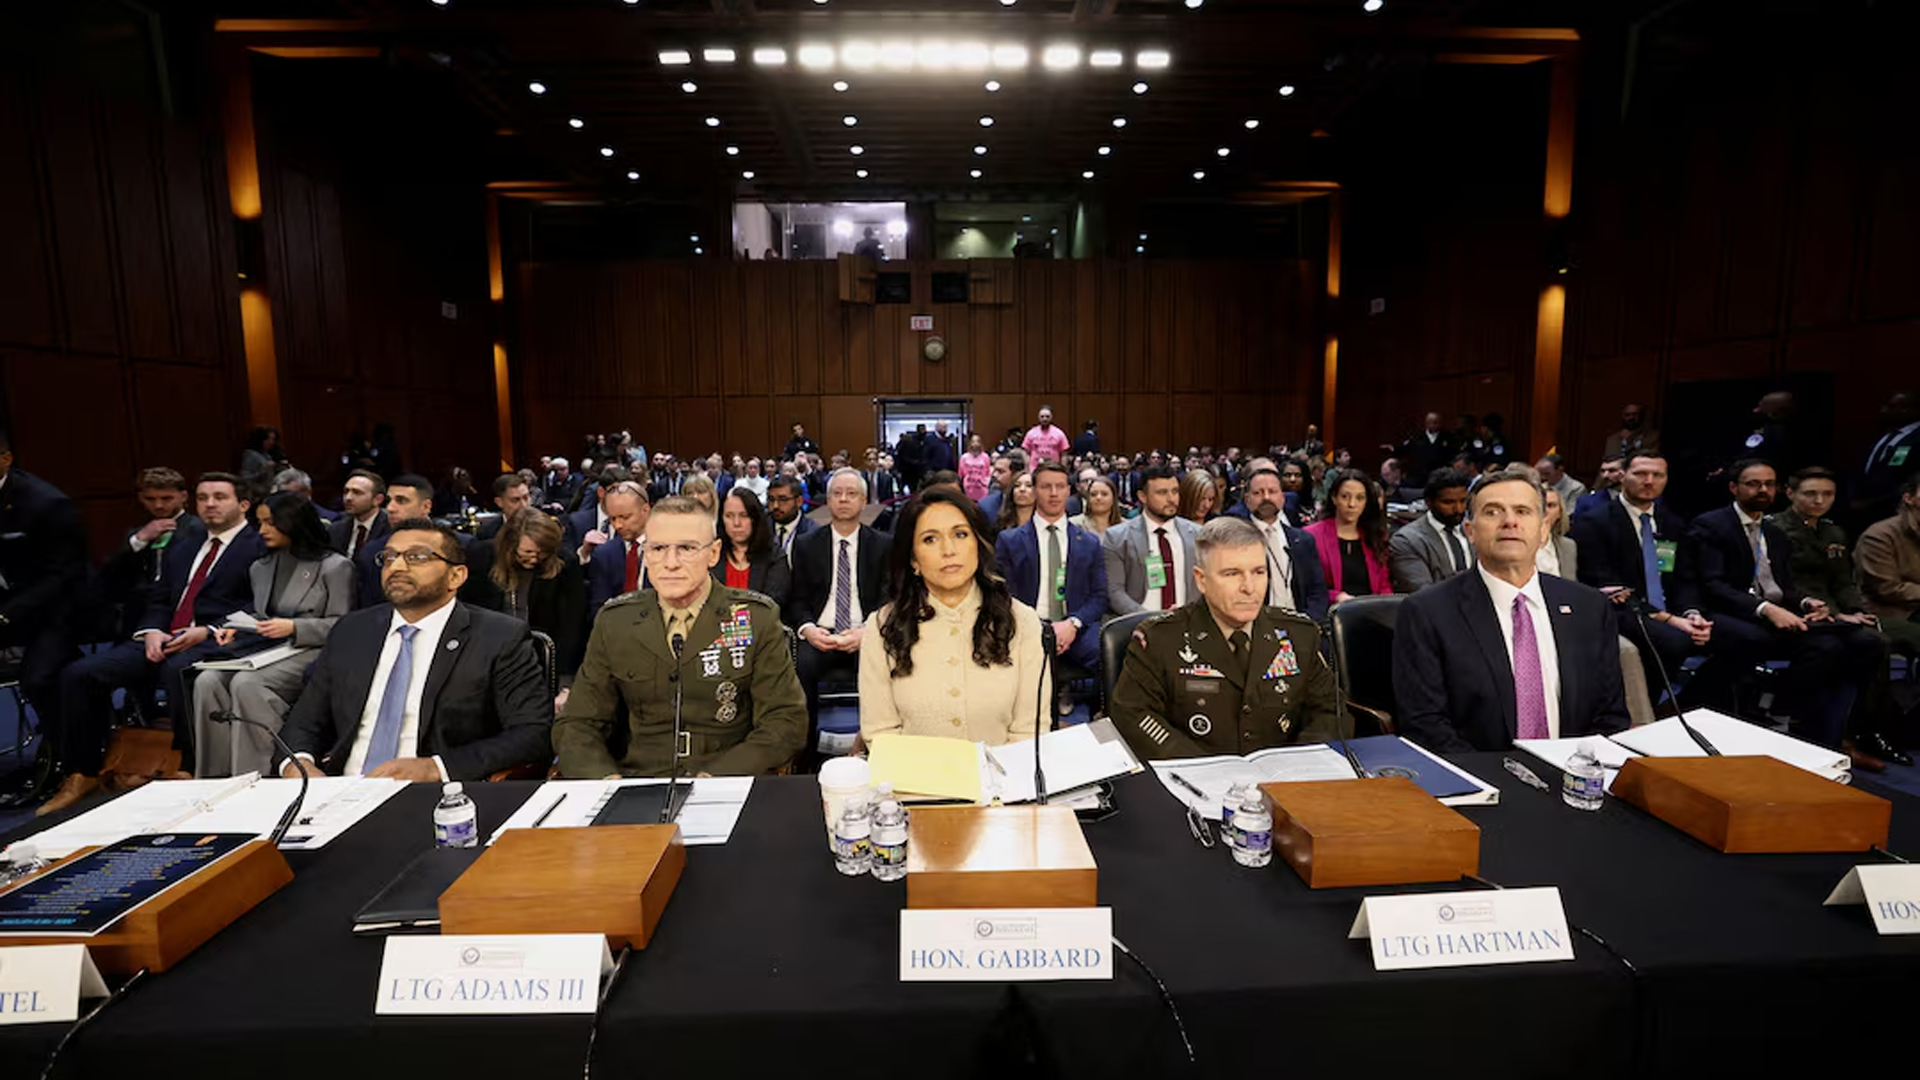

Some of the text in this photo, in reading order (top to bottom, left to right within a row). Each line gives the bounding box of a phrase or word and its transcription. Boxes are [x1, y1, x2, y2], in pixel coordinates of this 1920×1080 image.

[1382, 929, 1562, 958] LTG HARTMAN
[910, 948, 1101, 969] HON. GABBARD
[390, 978, 585, 1001] LTG ADAMS III
